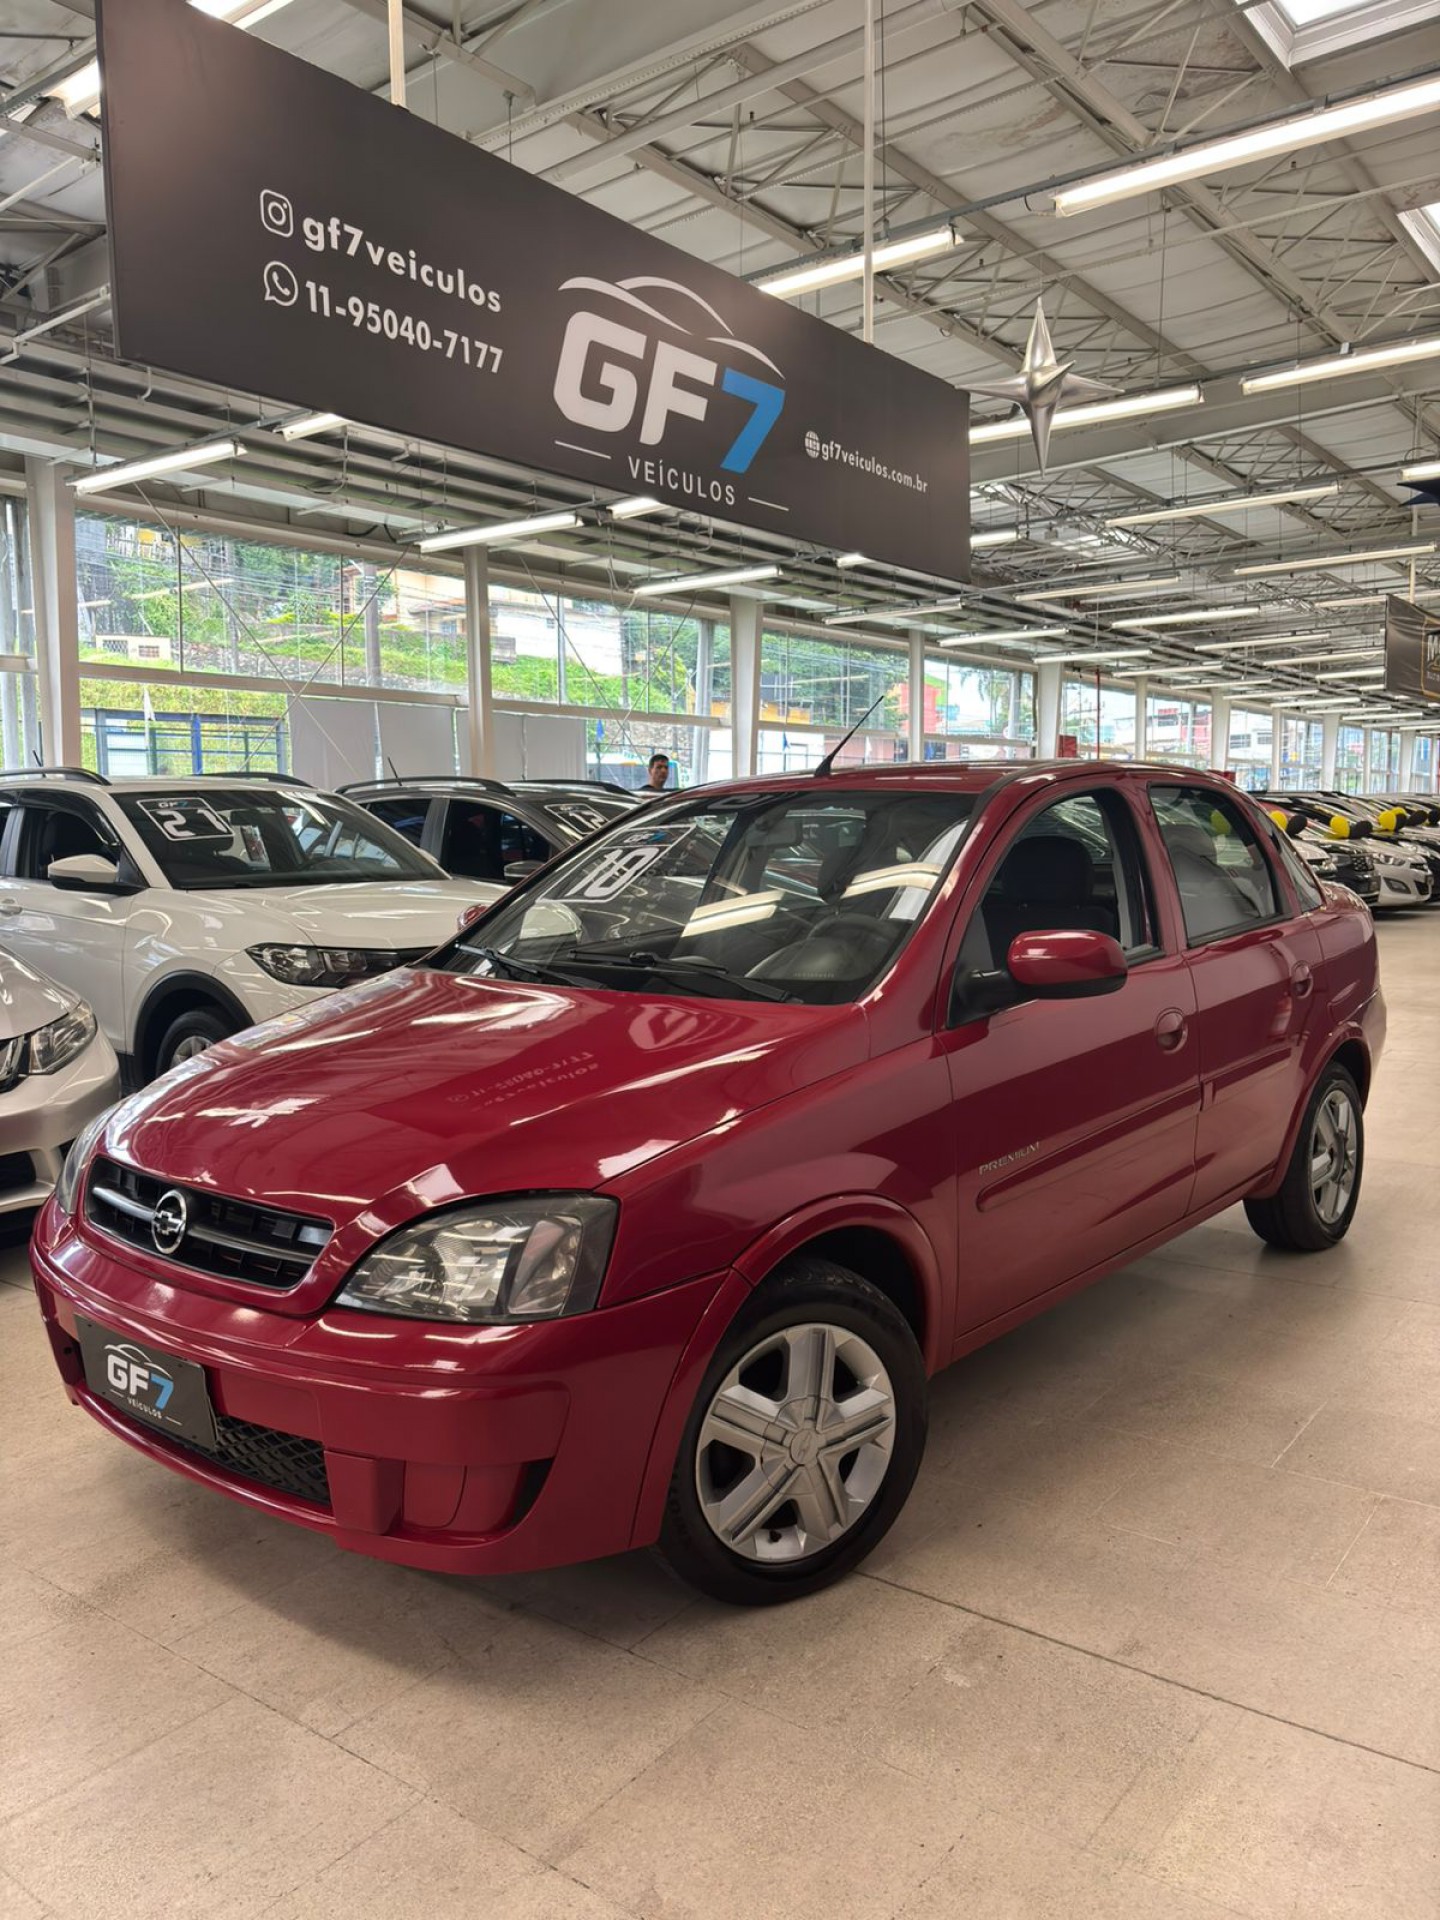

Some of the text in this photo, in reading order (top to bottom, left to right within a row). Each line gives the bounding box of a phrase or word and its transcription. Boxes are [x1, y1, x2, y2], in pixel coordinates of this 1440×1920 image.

[303, 216, 502, 313] gf7veiculos
[305, 281, 503, 373] 11-95040-7177
[553, 311, 786, 474] GF7
[628, 455, 736, 506] VEÍCULOS
[821, 441, 928, 494] gf7veiculos.com.br
[156, 809, 229, 837] 21
[978, 1141, 1039, 1175] PREMIUM
[107, 1353, 174, 1410] GF7
